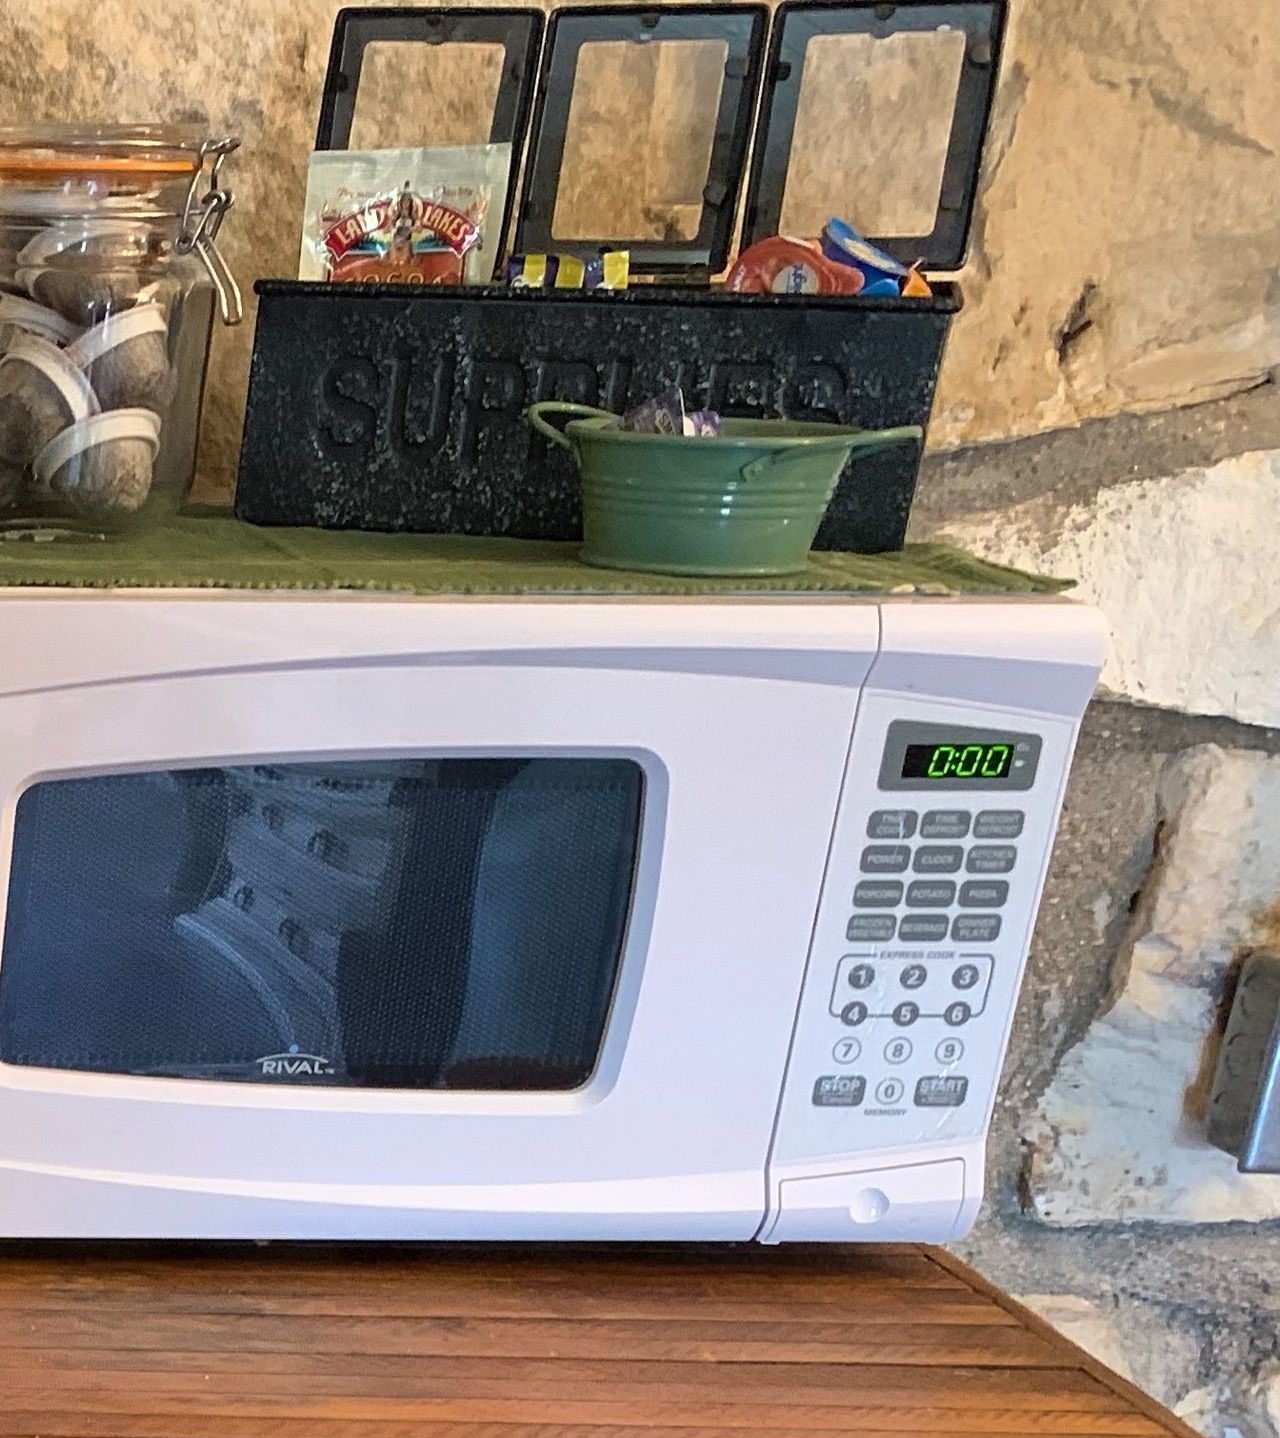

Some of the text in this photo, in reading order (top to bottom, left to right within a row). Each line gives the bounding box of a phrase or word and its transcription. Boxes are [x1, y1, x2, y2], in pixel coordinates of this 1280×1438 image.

[422, 204, 470, 242] LAKES
[927, 745, 1010, 777] 0:00
[857, 969, 973, 985] 1 2 3
[847, 1006, 964, 1022] 4 5 6
[841, 1043, 956, 1058] 7 8 9
[262, 1060, 324, 1075] RIVAL
[819, 1079, 965, 1099] STOP 0 START
